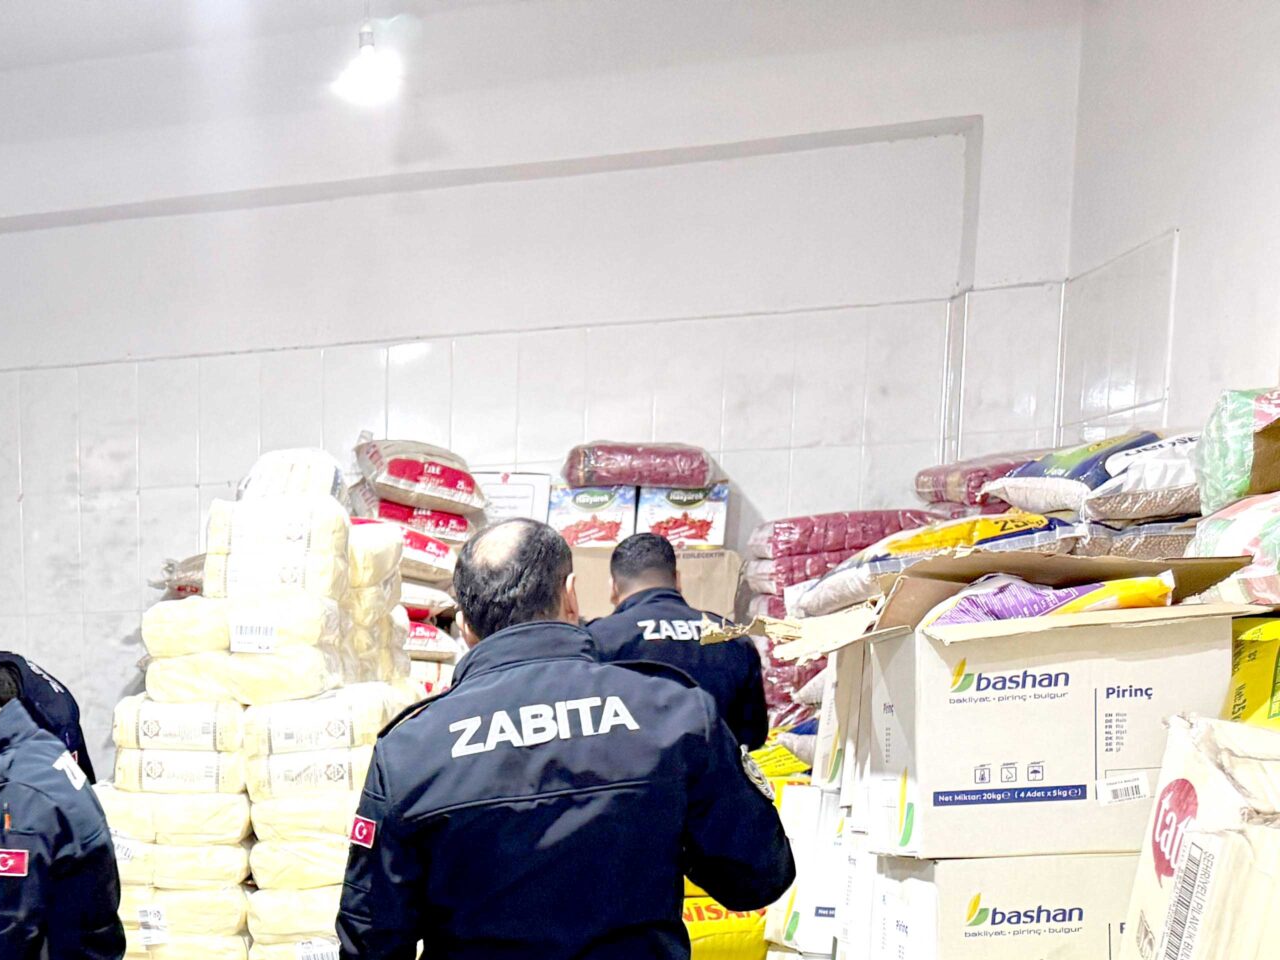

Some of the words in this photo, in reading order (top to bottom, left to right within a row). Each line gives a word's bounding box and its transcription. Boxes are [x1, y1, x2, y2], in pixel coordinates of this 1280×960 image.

[975, 670, 1070, 692] bashan
[949, 695, 992, 704] bakliyat
[997, 693, 1027, 702] pirinç
[1033, 691, 1069, 701] bulgur
[1105, 686, 1154, 699] Pirinç
[449, 695, 640, 758] ZABITA
[938, 794, 953, 802] Net
[954, 792, 981, 801] Miktar:
[1025, 789, 1046, 798] Adet
[990, 904, 1084, 926] bashan
[964, 929, 1007, 939] bakliyat
[1012, 927, 1043, 938] pirinç
[1047, 925, 1083, 935] bulgur
